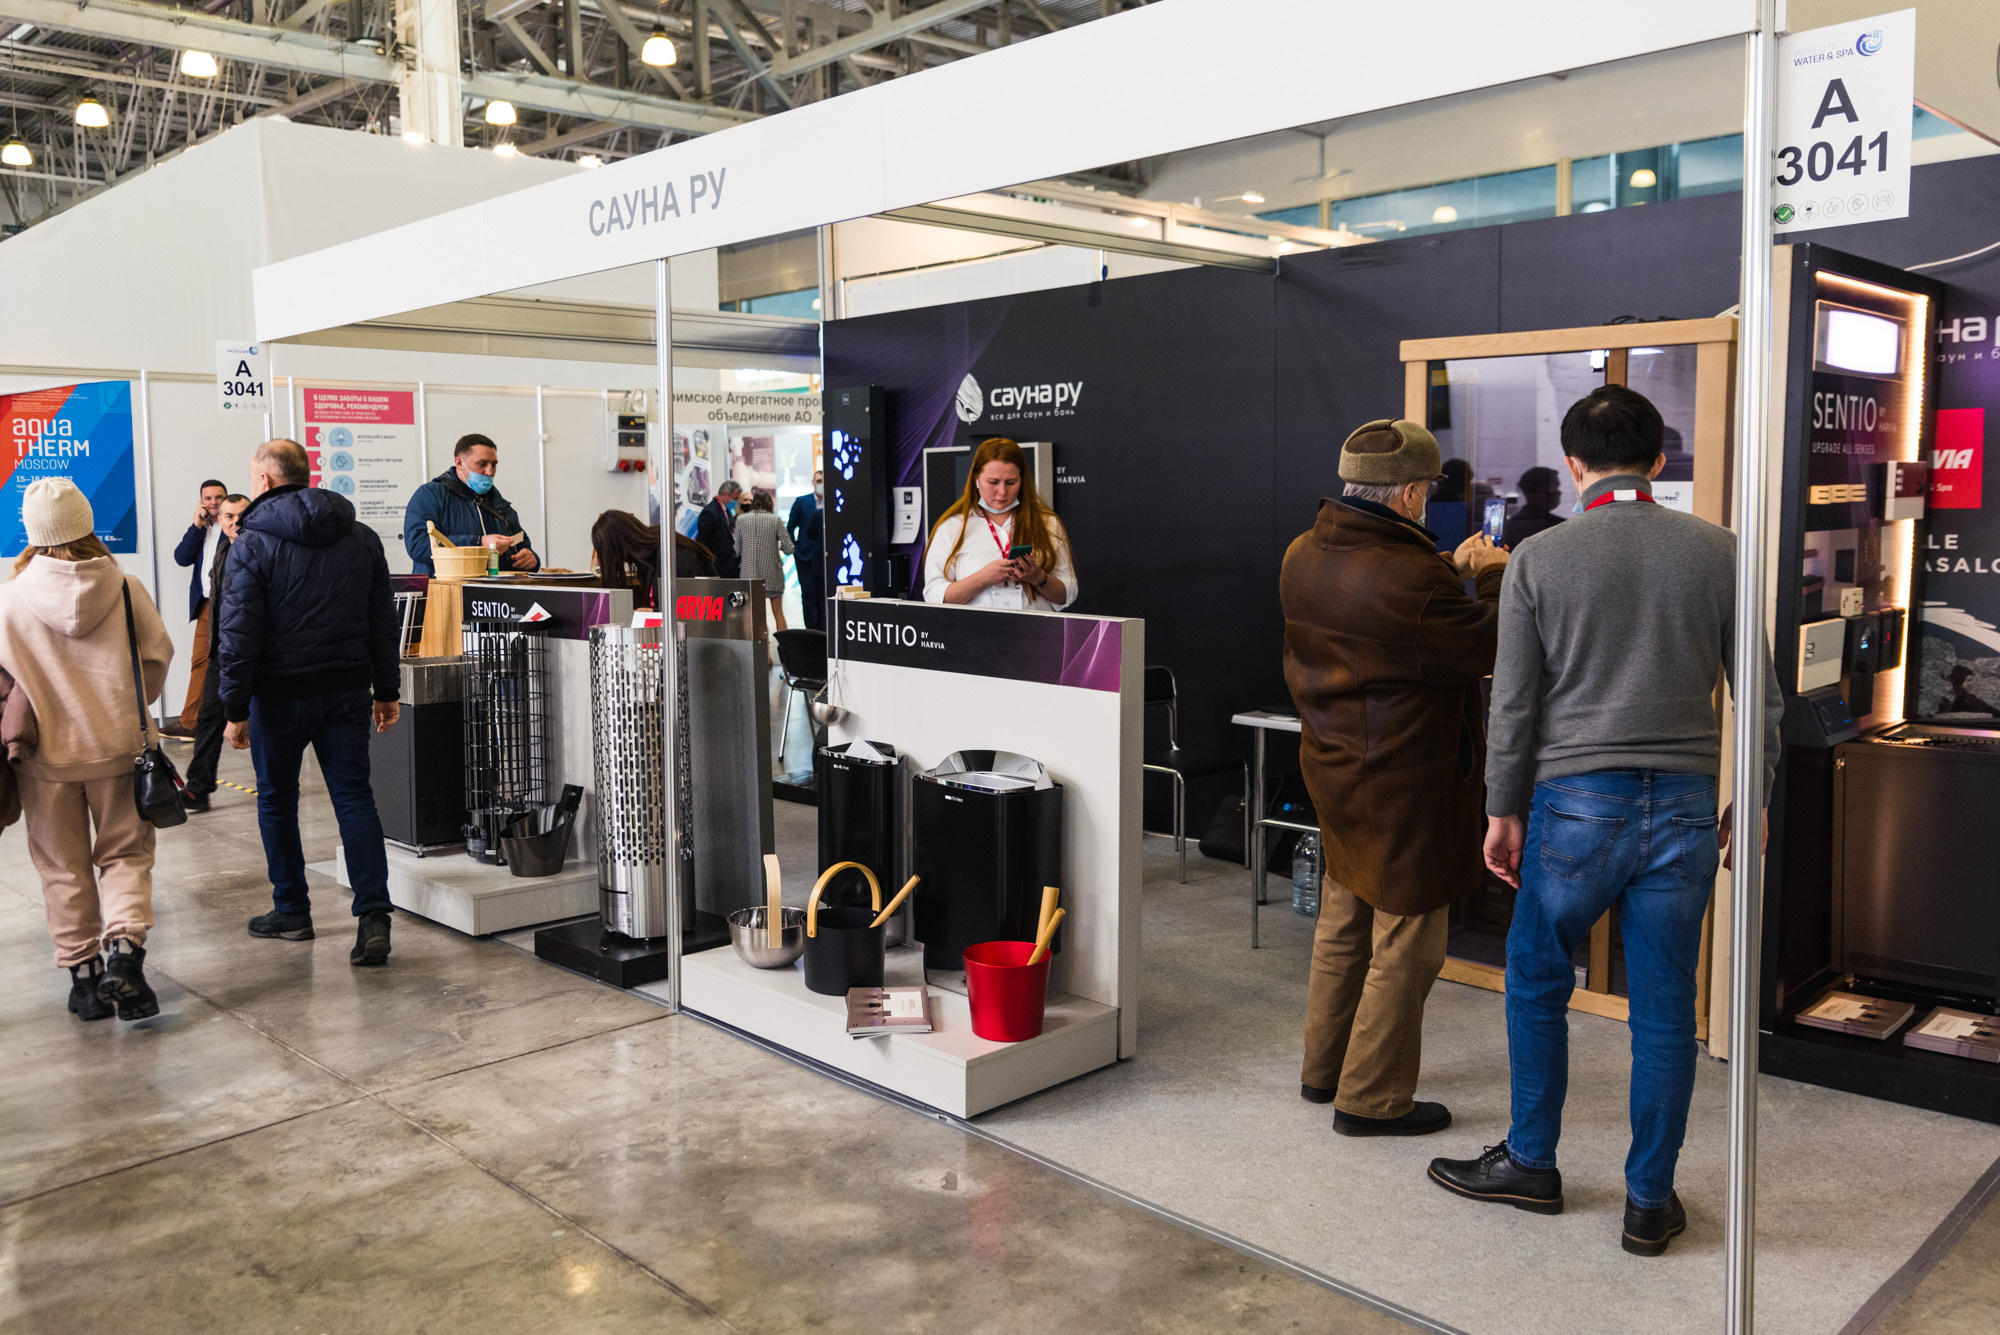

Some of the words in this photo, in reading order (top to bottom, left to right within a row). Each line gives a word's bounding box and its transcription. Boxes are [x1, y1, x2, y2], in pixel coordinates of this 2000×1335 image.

[1793, 53, 1825, 67] WATER
[1826, 51, 1834, 61] &
[1835, 47, 1854, 59] SPA
[1811, 78, 1859, 129] A
[1776, 131, 1888, 187] 3041
[589, 181, 681, 236] САУНА
[690, 167, 727, 214] РУ
[235, 360, 252, 377] A
[223, 381, 263, 397] 3041
[726, 392, 795, 407] Агрегатное
[708, 409, 791, 423] объединение
[794, 411, 812, 423] АО
[990, 413, 1004, 421] все
[1006, 412, 1021, 420] для
[1813, 391, 1877, 432] SENTIO
[12, 418, 72, 441] aqua
[14, 439, 90, 457] THERM
[14, 459, 69, 470] MOSCOW
[1056, 466, 1066, 474] BY
[1056, 475, 1086, 484] HARVIA
[471, 600, 510, 619] SENTIO
[675, 595, 725, 622] ARVIA
[845, 619, 917, 647] SENTIO
[920, 631, 929, 639] BY
[920, 640, 946, 650] HARVIA
